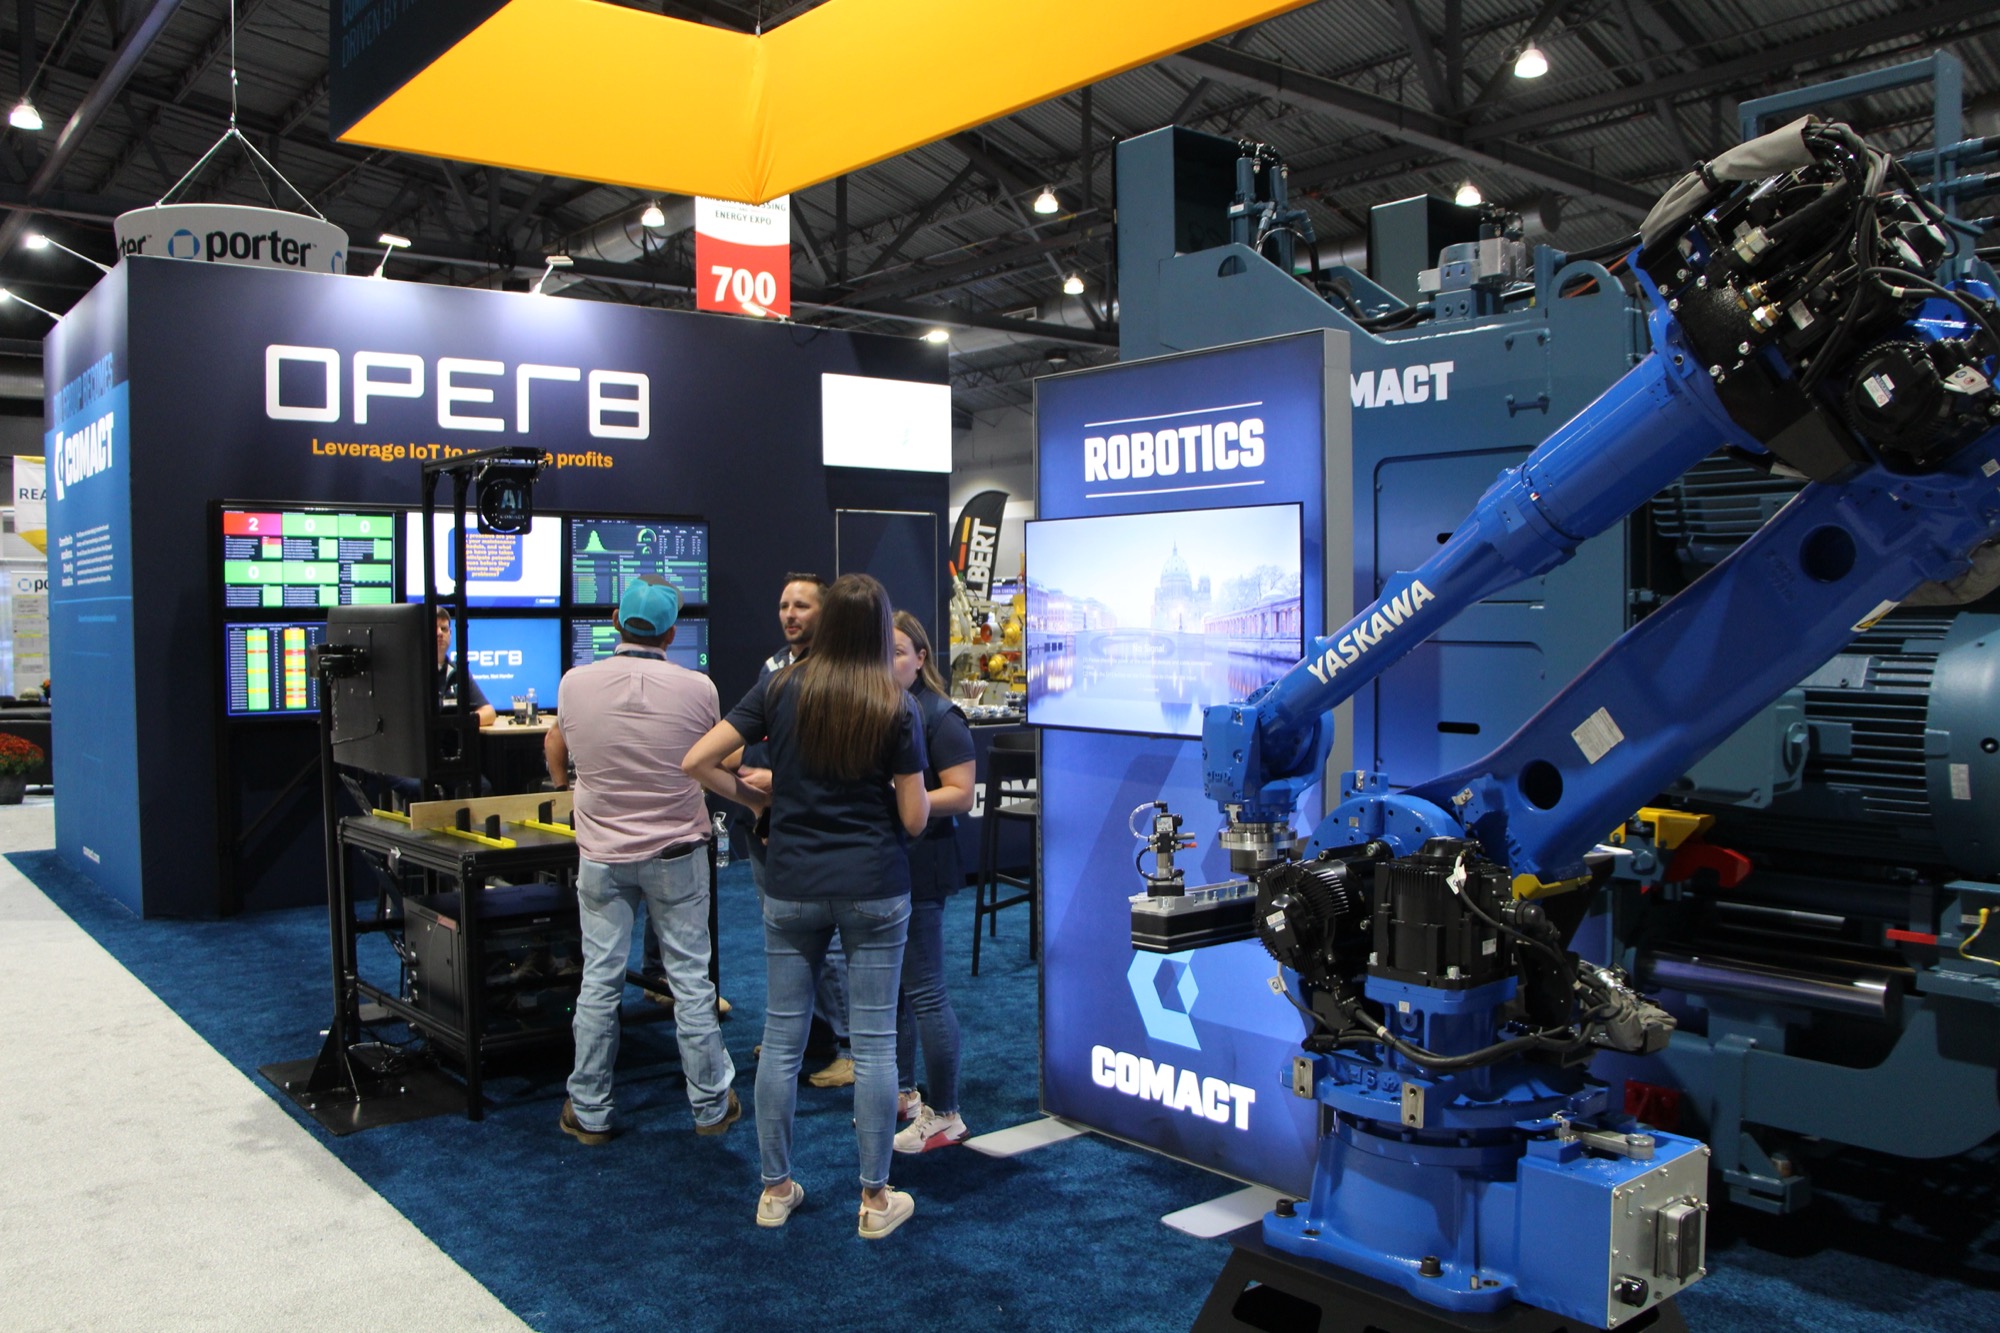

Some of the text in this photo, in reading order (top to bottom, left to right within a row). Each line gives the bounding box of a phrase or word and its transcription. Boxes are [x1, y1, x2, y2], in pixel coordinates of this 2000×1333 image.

[342, 4, 381, 68] DRIVEN
[715, 210, 772, 226] ENERGY EXPO
[711, 265, 777, 306] 700
[1350, 360, 1454, 409] MACT
[65, 411, 114, 487] COMACT
[312, 438, 405, 461] Leverage
[410, 443, 440, 460] IoT
[557, 451, 614, 468] profits
[1084, 418, 1265, 482] ROBOTICS
[501, 489, 522, 509] AI
[248, 517, 259, 531] 2
[305, 519, 315, 532] 0
[360, 520, 370, 533] 0
[248, 565, 259, 579] 0
[305, 566, 316, 579] 0
[965, 517, 997, 600] LBERT
[1307, 579, 1436, 685] YASKAWA
[700, 653, 708, 666] 3
[1091, 1044, 1256, 1131] COMACT
